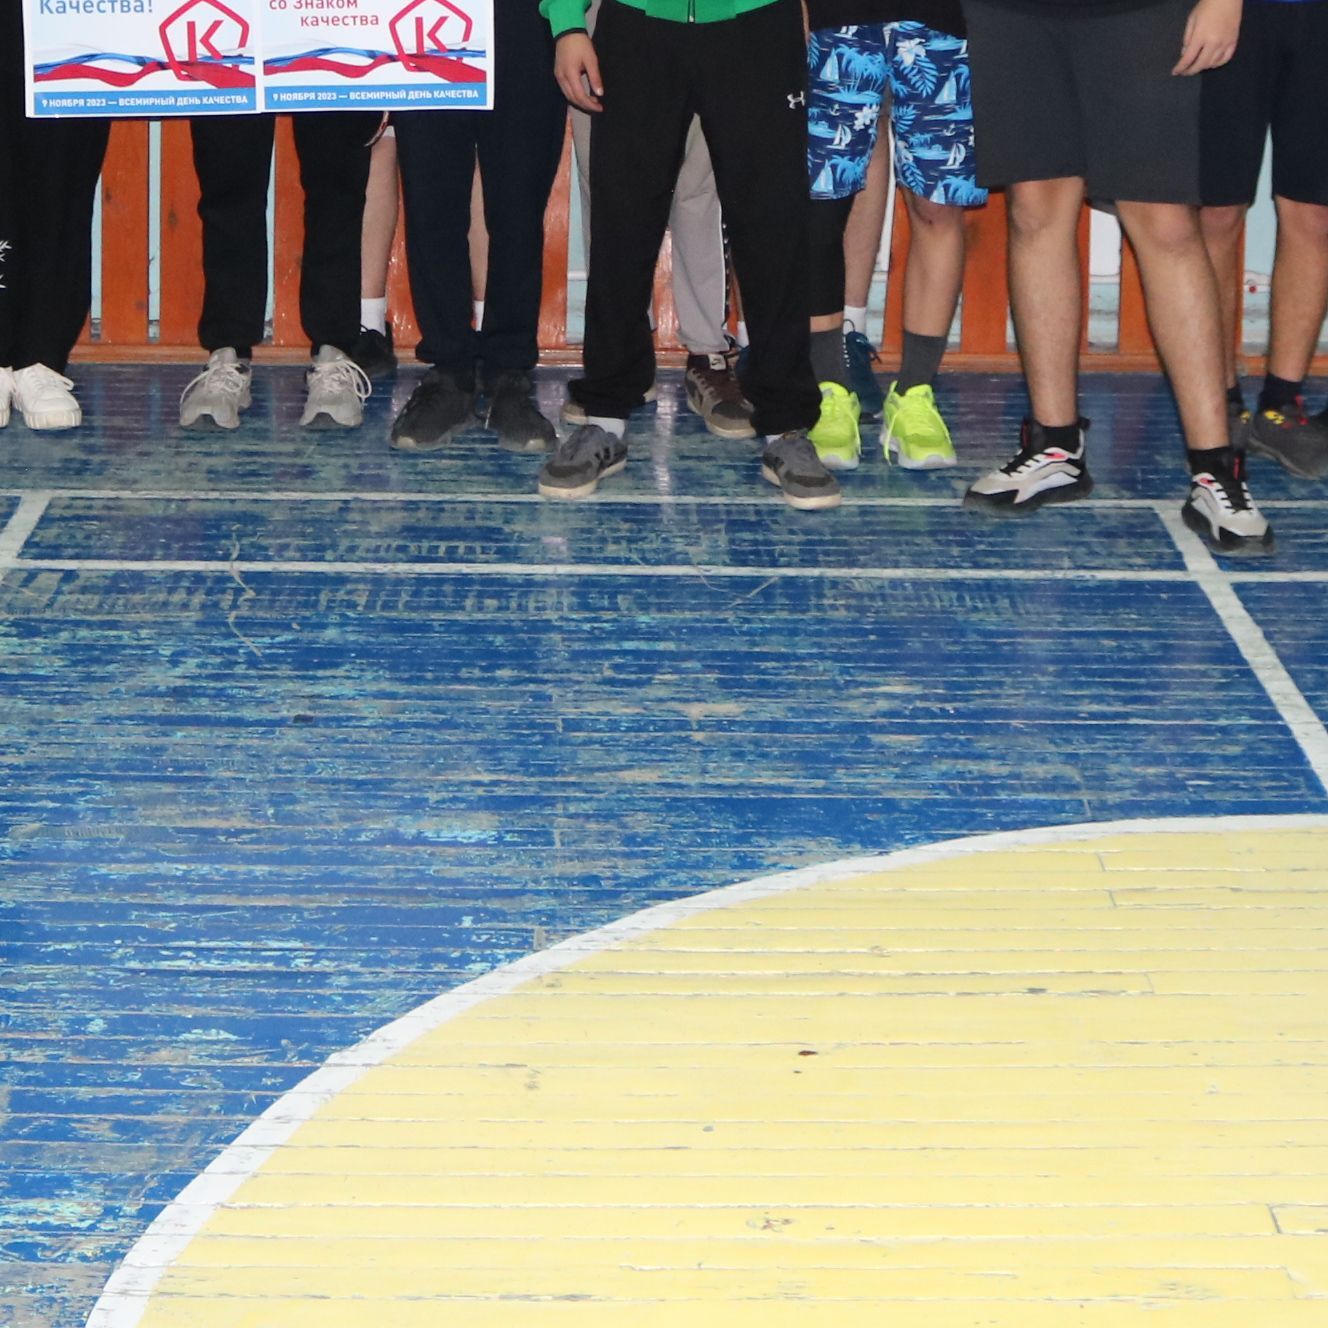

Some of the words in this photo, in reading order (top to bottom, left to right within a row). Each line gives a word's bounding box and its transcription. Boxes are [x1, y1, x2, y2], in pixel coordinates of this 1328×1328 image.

[300, 14, 379, 27] качества
[42, 99, 48, 108] 9
[49, 98, 85, 107] НОЯБРЯ
[86, 98, 106, 107] 2023
[119, 96, 175, 106] ВСЕМИРНЫЙ
[176, 97, 201, 107] ДЕНЬ
[202, 95, 248, 105] КАЧЕСТВА
[273, 93, 278, 102] 9
[280, 92, 316, 101] НОЯБРЯ
[317, 92, 337, 101] 2023
[349, 89, 406, 100] ВСЕМИРНЫЙ
[407, 90, 432, 101] ДЕНЬ
[433, 90, 479, 100] КАЧЕСТВА
